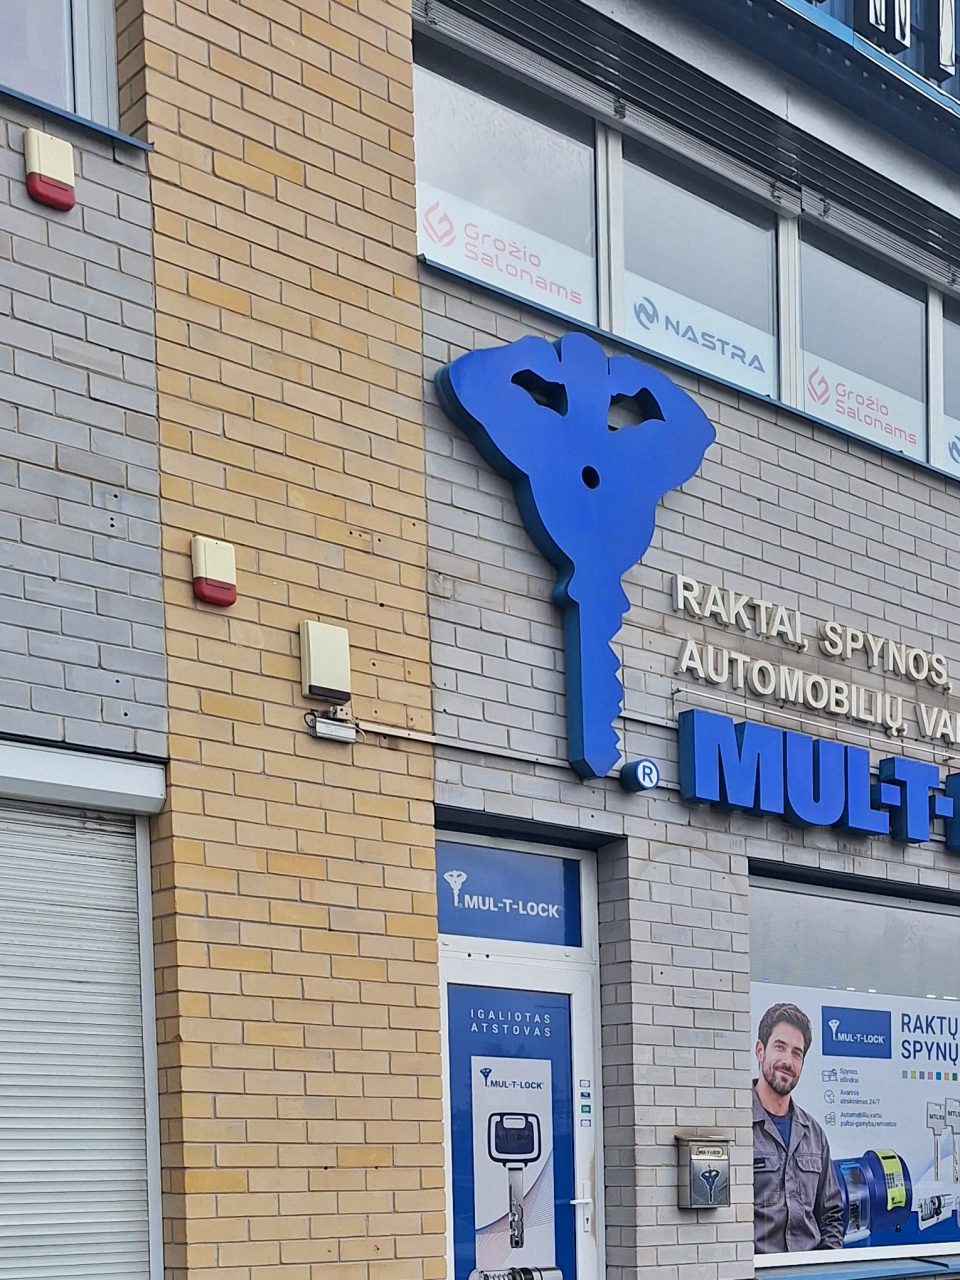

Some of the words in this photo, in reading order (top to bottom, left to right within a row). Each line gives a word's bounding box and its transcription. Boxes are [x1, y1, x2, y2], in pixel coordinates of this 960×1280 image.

[464, 223, 542, 268] Grožio
[464, 242, 582, 304] Salonams
[665, 319, 766, 374] NASTRA
[835, 382, 889, 416] Grožio
[835, 399, 917, 445] Salonams
[672, 573, 809, 653] RAKTAI,
[820, 620, 953, 694] SPYNOS,
[676, 636, 909, 737] AUTOMOBILIŲ,
[470, 1008, 551, 1024] IGALIOTAS
[470, 1022, 551, 1038] ATSTOVAS
[900, 1012, 959, 1041] RAKTŲ
[900, 1039, 959, 1067] SPYNŲ
